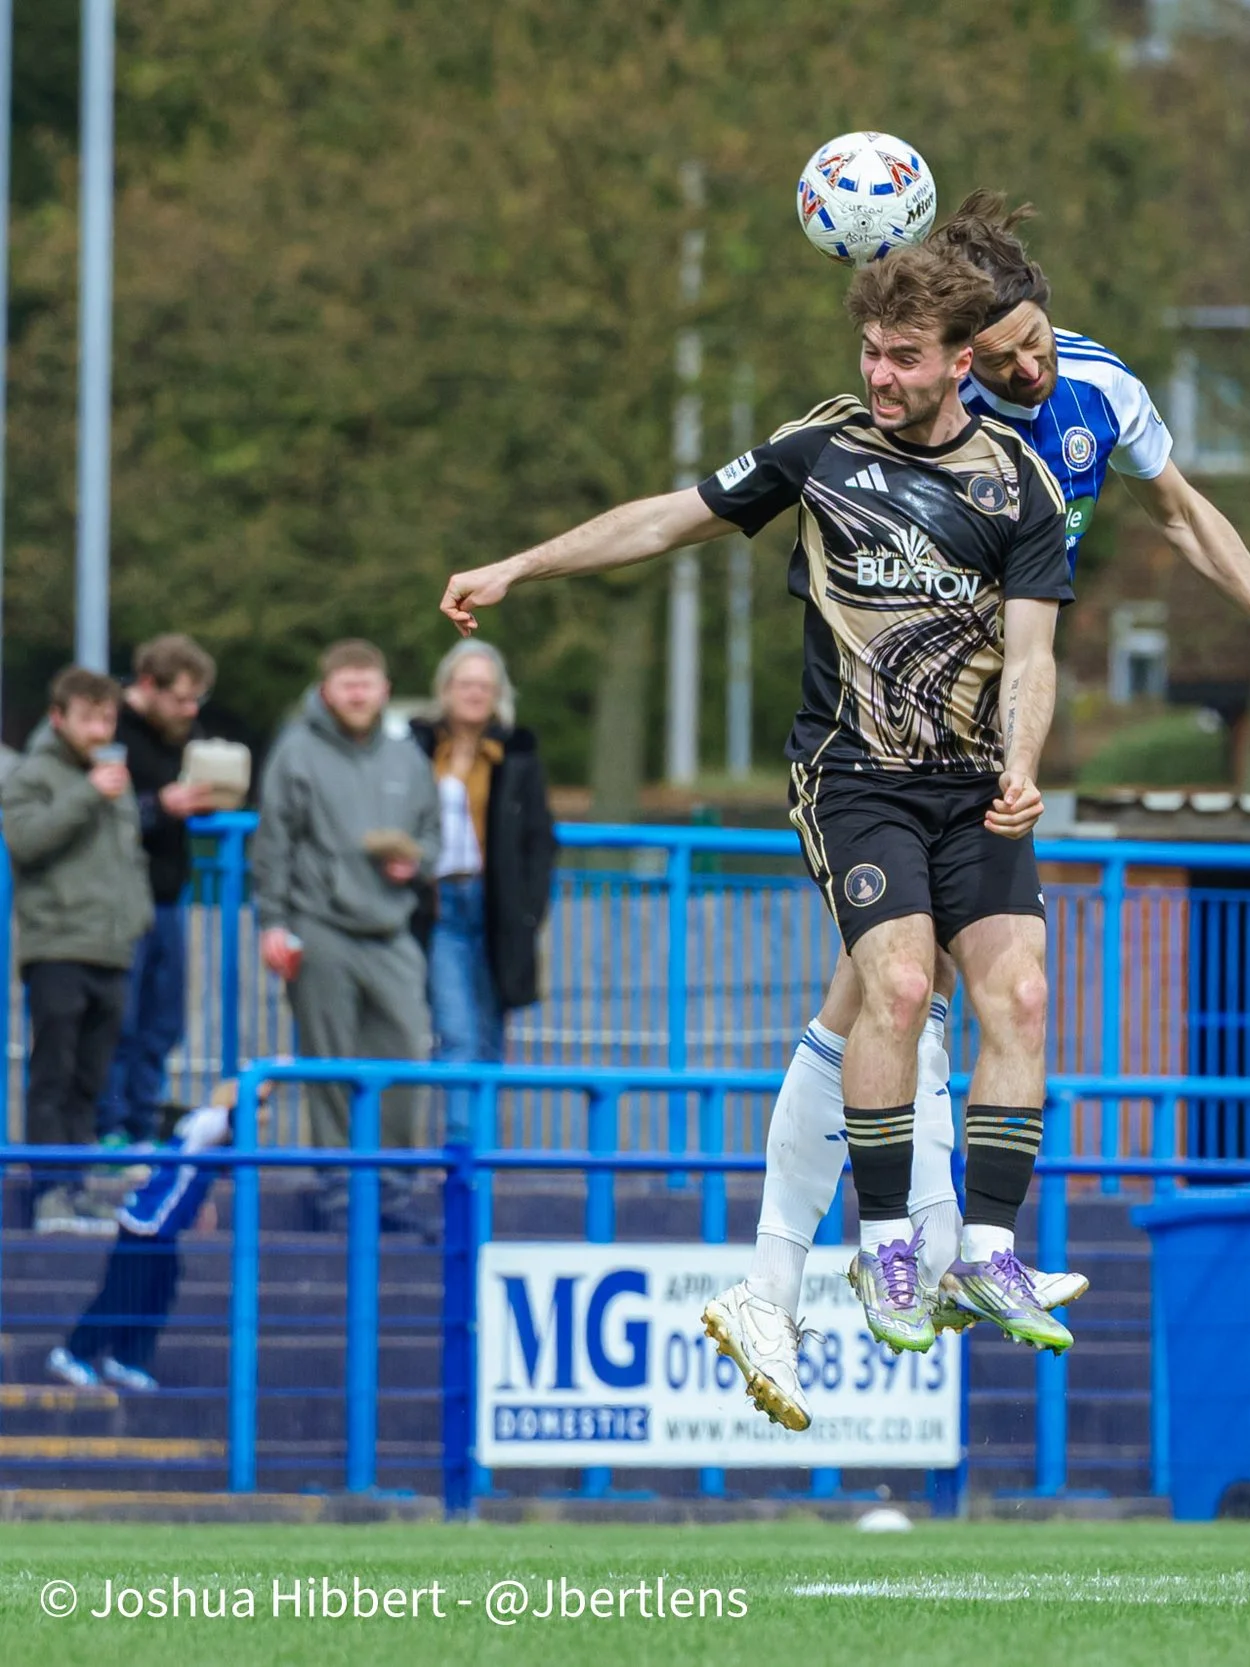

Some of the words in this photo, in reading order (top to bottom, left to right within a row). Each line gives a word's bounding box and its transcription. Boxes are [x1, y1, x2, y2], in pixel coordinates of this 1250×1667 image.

[1065, 507, 1082, 529] le
[857, 556, 981, 604] BUXTON
[495, 1268, 652, 1390] MG
[496, 1407, 647, 1440] DOMESTIC
